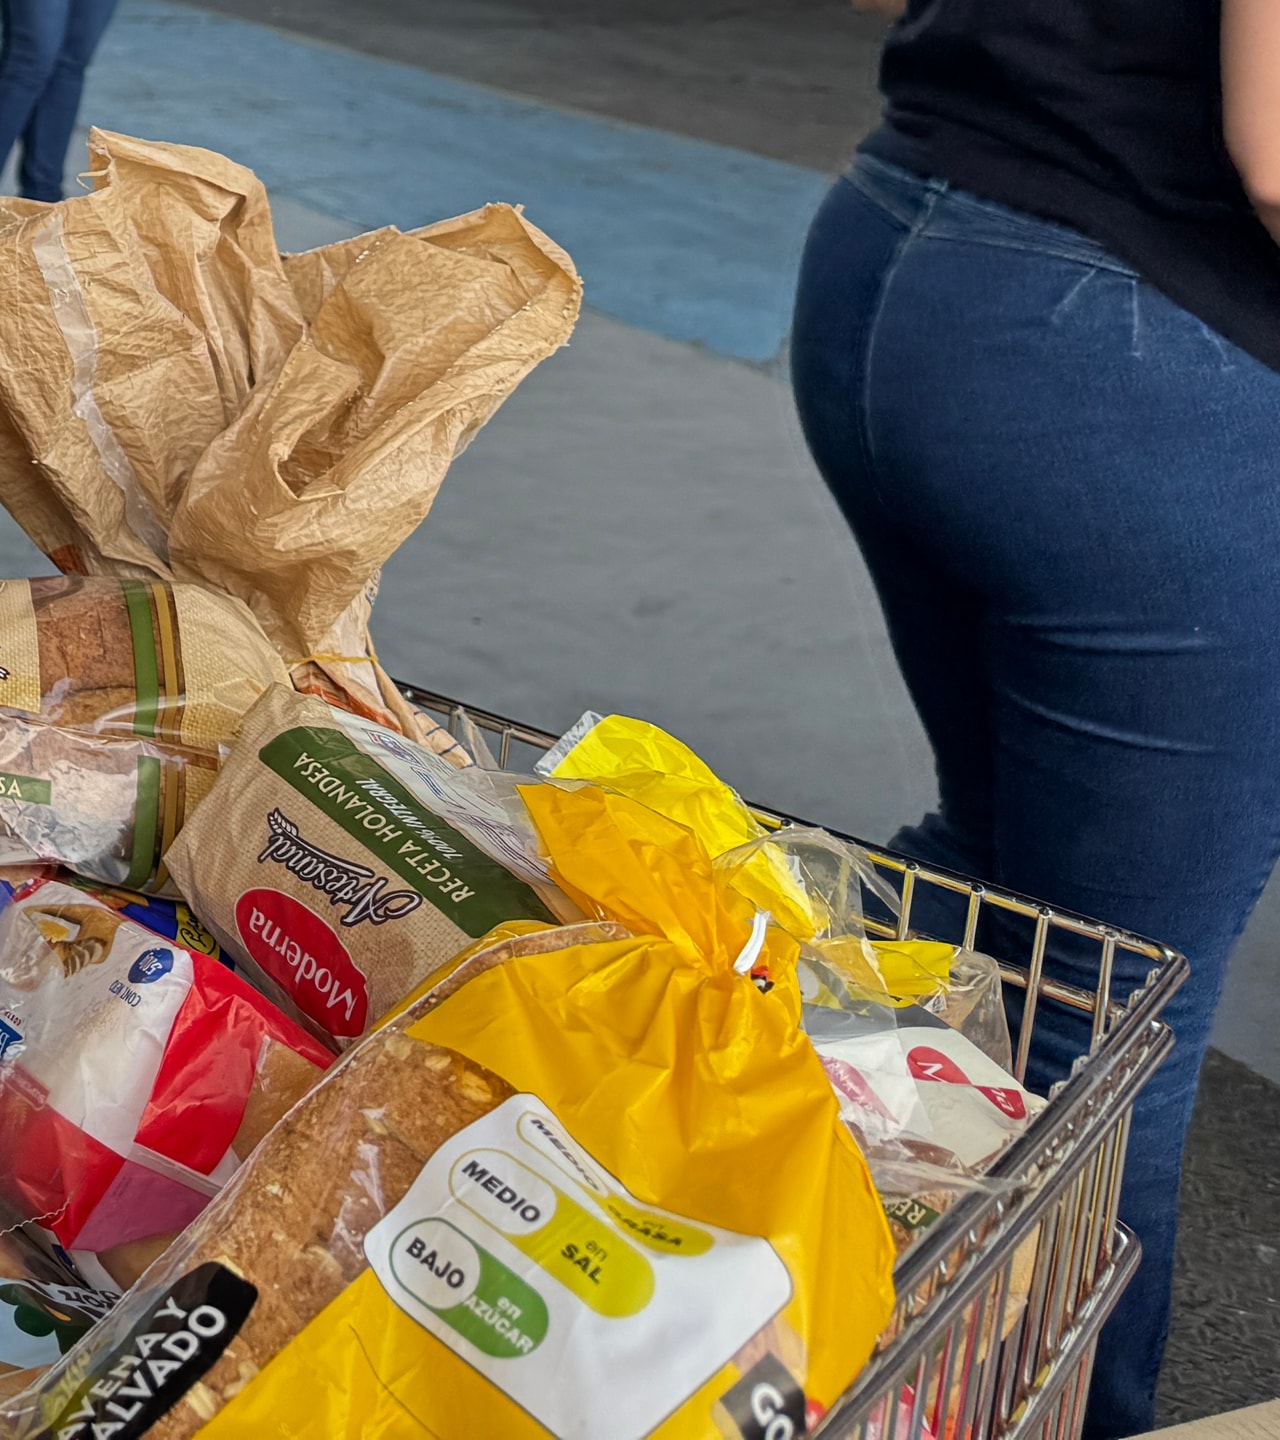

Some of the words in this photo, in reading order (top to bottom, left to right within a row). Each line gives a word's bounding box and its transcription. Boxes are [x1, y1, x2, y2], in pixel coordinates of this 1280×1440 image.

[291, 750, 403, 845] HOLANDESA
[354, 777, 426, 834] INTEGRAL
[256, 830, 424, 928] Artesanal
[395, 838, 476, 904] RECETA
[247, 906, 359, 1022] Moderna
[530, 1117, 600, 1192] MEDIO
[460, 1159, 542, 1224] MEDIO
[404, 1237, 466, 1290] BAJO
[560, 1241, 604, 1287] SAL
[584, 1239, 609, 1263] en
[461, 1293, 535, 1356] AZÚCAR
[495, 1295, 523, 1321] en
[57, 1330, 169, 1440] AVENA
[154, 1295, 189, 1321] Y
[90, 1304, 228, 1440] ALVADO
